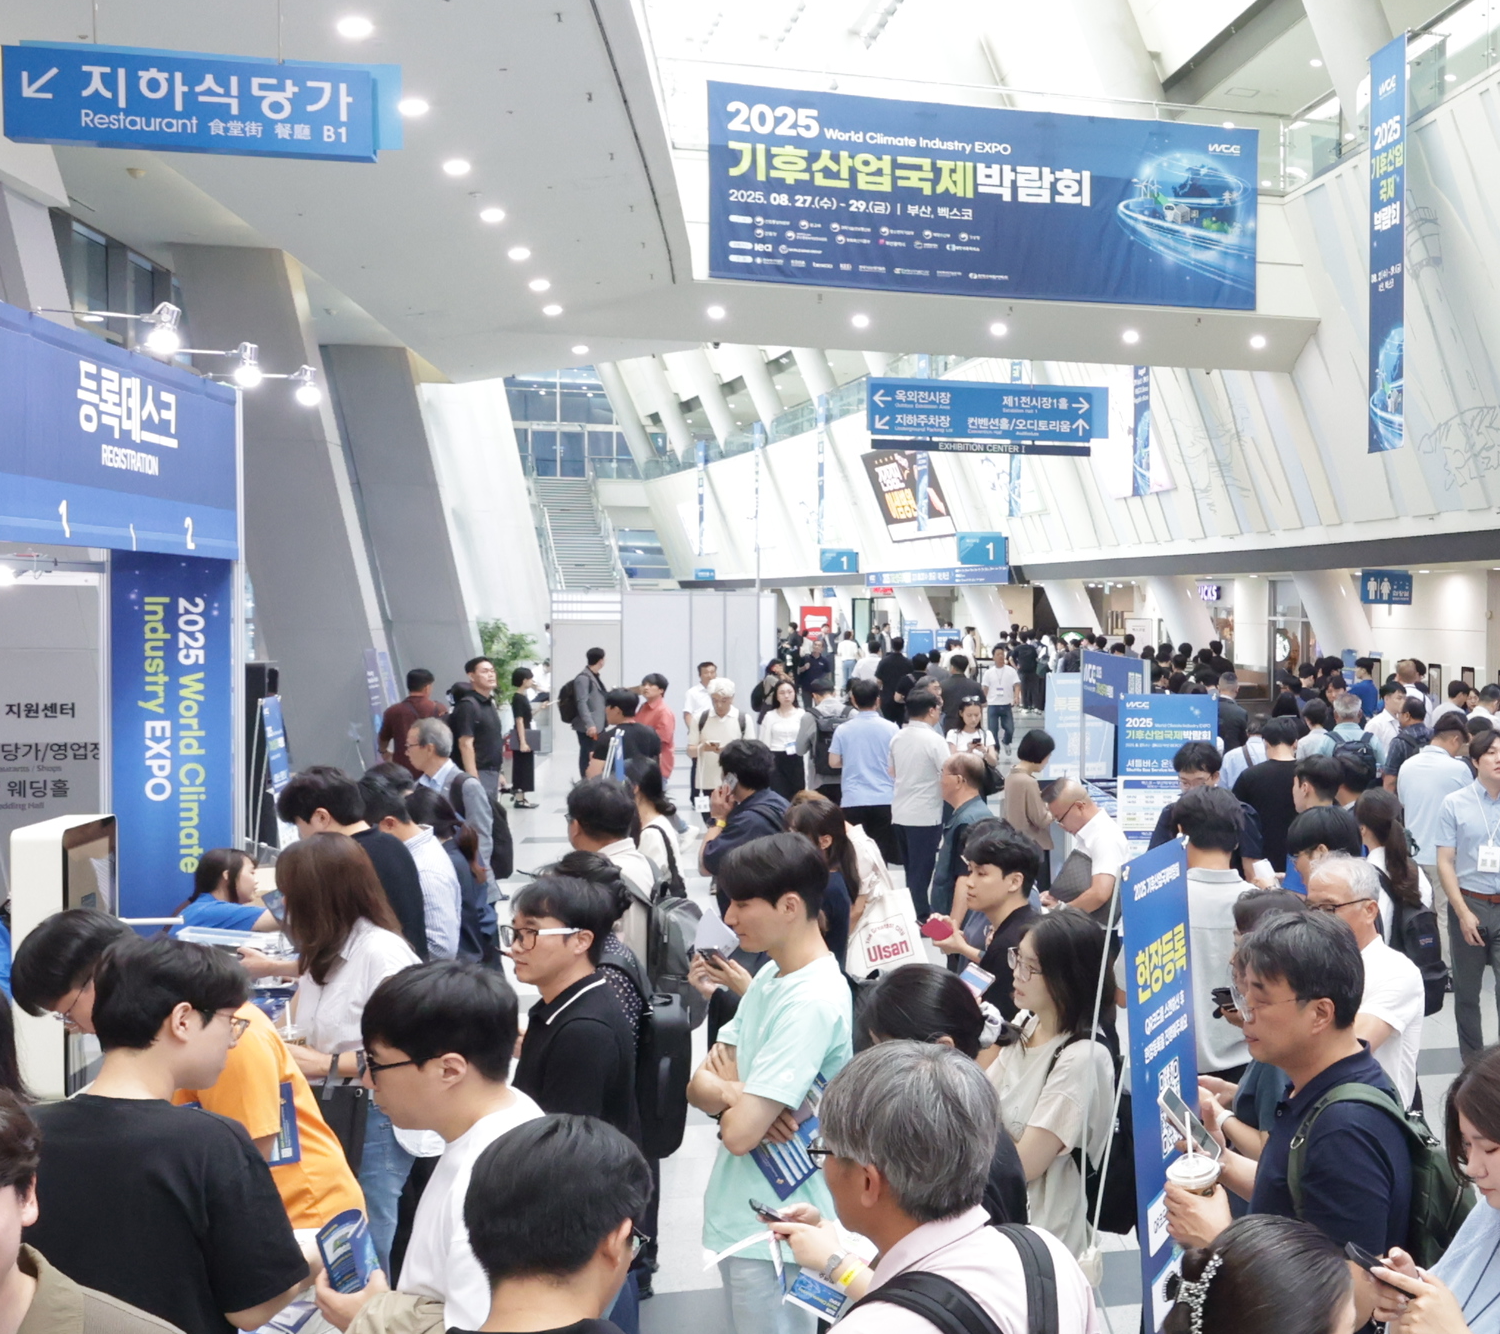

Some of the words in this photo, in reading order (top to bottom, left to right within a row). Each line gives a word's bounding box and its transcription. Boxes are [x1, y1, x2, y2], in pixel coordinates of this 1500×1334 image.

[80, 65, 354, 122] 지하식당가
[80, 109, 199, 134] Restaurant
[207, 118, 263, 139] 食堂街
[323, 125, 348, 143] B1
[726, 101, 820, 138] 2025
[824, 127, 863, 143] World
[866, 130, 916, 148] Climate
[919, 135, 973, 155] Industry
[974, 141, 1011, 156] EXPO
[1374, 115, 1401, 152] 2025
[728, 141, 1092, 207] 기후산업국제박람회
[1371, 142, 1404, 180] 기후산업
[1379, 175, 1395, 202] 국제
[729, 189, 767, 205] 2025.
[770, 192, 792, 207] 08.
[937, 204, 973, 221] 벡스코
[1373, 200, 1400, 232] 박람회
[76, 359, 179, 449] 등록데스크
[894, 389, 952, 405] 옥외전시장
[894, 414, 951, 428] 지하주차장
[967, 417, 1072, 433] 컨벤션홀/오디토리움
[101, 444, 159, 477] REGISTRATION
[938, 441, 984, 452] EXHIBITION
[986, 443, 1020, 453] CENTER
[57, 500, 71, 539] 1
[184, 516, 196, 550] 2
[986, 540, 994, 561] 1
[176, 596, 205, 666] 2025
[138, 596, 170, 715] Industry
[5, 702, 76, 719] 지원센터
[176, 671, 206, 756] World
[1125, 717, 1153, 728] 2025
[1125, 729, 1212, 741] 기후산업국제박람회
[36, 764, 62, 773] Shops
[143, 719, 172, 803] EXPO
[1126, 759, 1159, 769] 셔틀버스
[7, 778, 70, 799] 웨딩홀
[177, 761, 207, 875] Climate
[1133, 880, 1146, 902] 2025
[866, 939, 910, 963] Ulsan
[1135, 922, 1188, 1005] 현장등록
